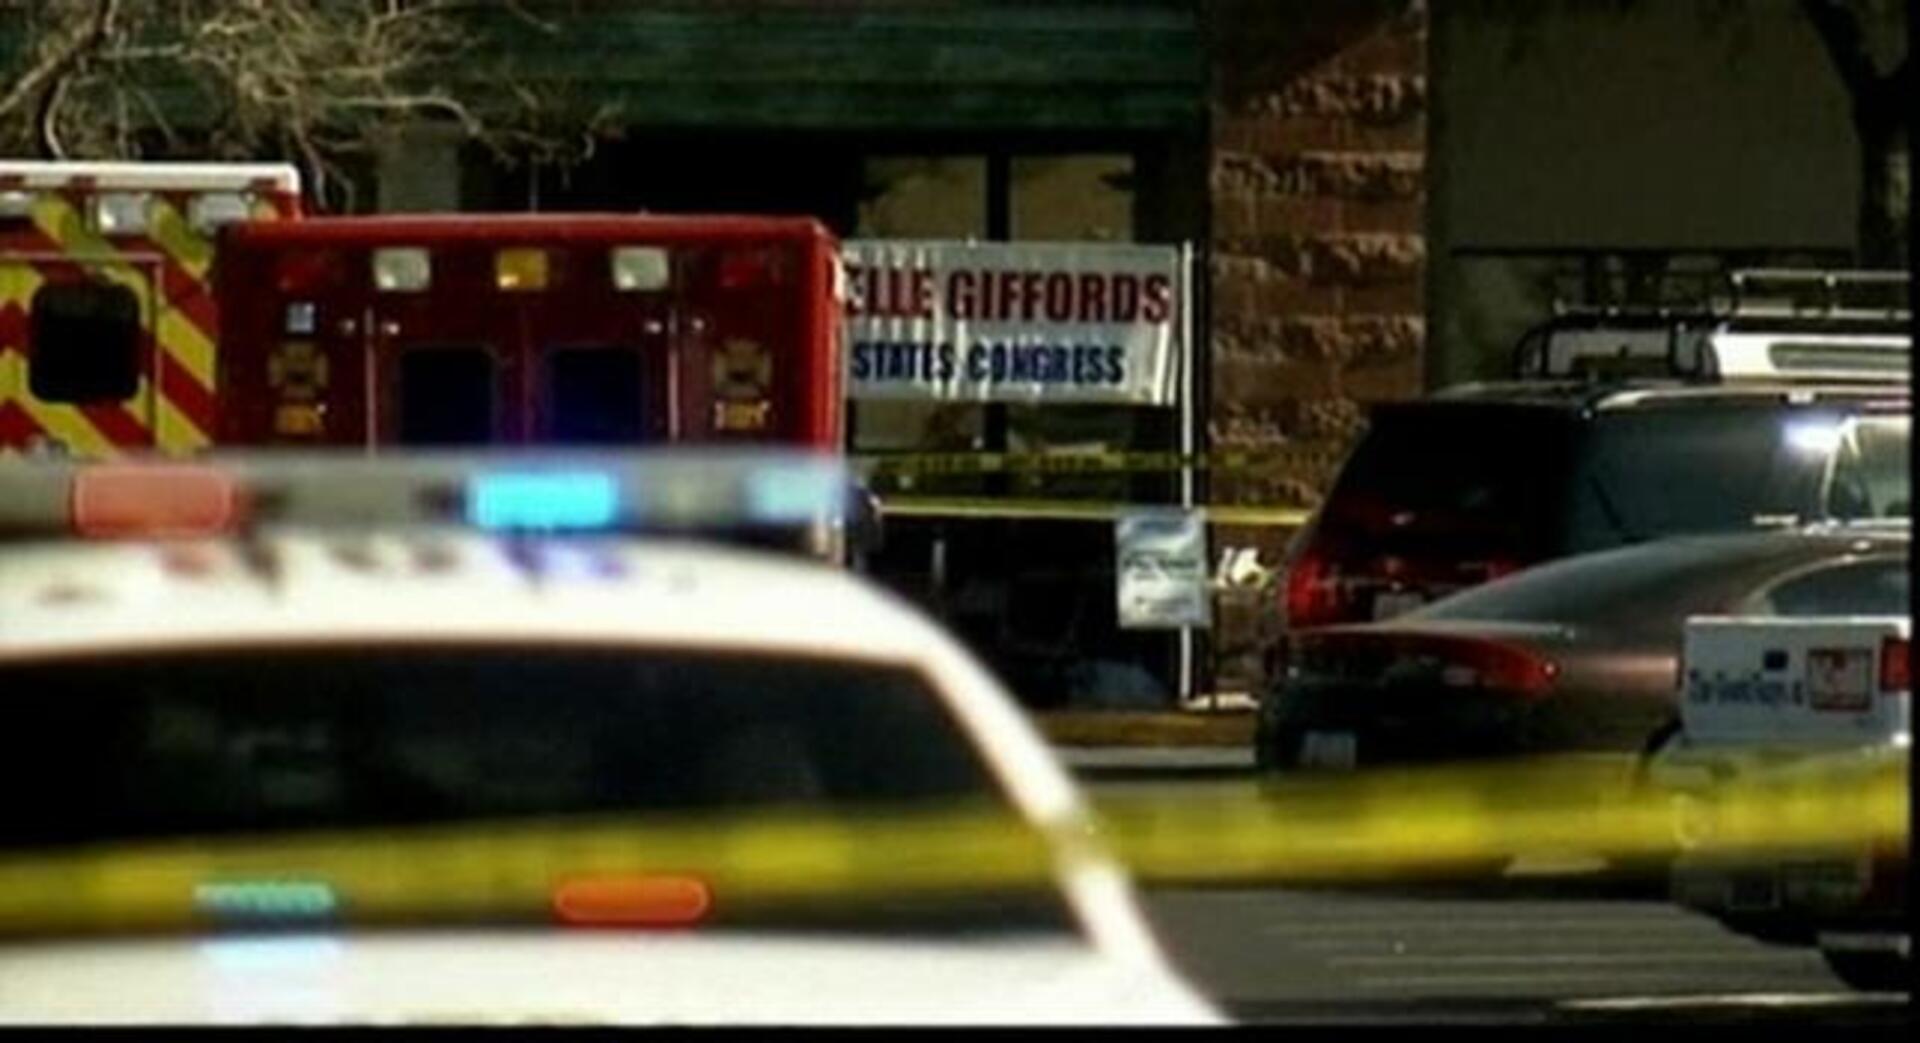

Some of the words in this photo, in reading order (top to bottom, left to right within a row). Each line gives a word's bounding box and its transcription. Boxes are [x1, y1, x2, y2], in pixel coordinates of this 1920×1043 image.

[949, 268, 1171, 325] GIFFORDS
[852, 340, 954, 384] STATES
[967, 343, 1124, 385] CONGRESS
